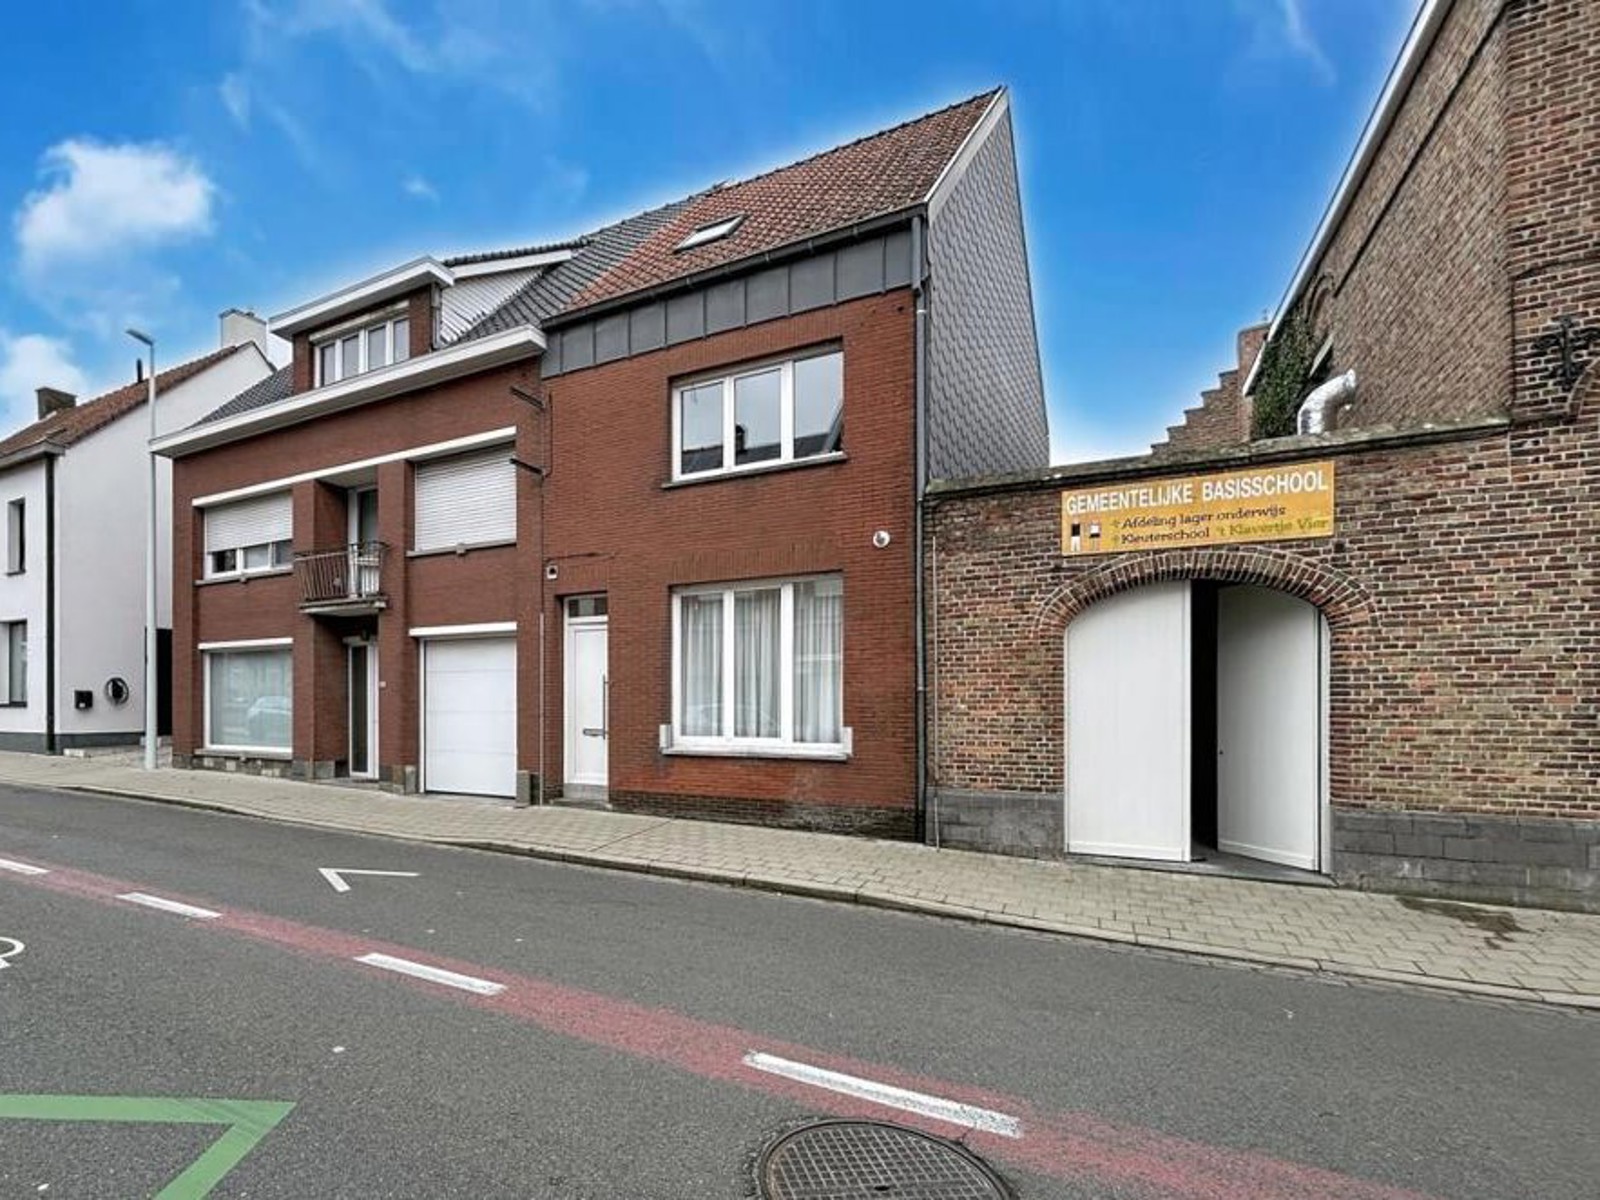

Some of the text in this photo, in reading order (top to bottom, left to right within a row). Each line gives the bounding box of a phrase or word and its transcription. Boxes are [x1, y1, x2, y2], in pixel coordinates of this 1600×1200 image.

[1066, 470, 1328, 515] GEMEENTELIJKE BASISSCHOOL
[1121, 505, 1286, 530] Afdeling lager onderwijs
[1121, 528, 1210, 545] Kleuterschool
